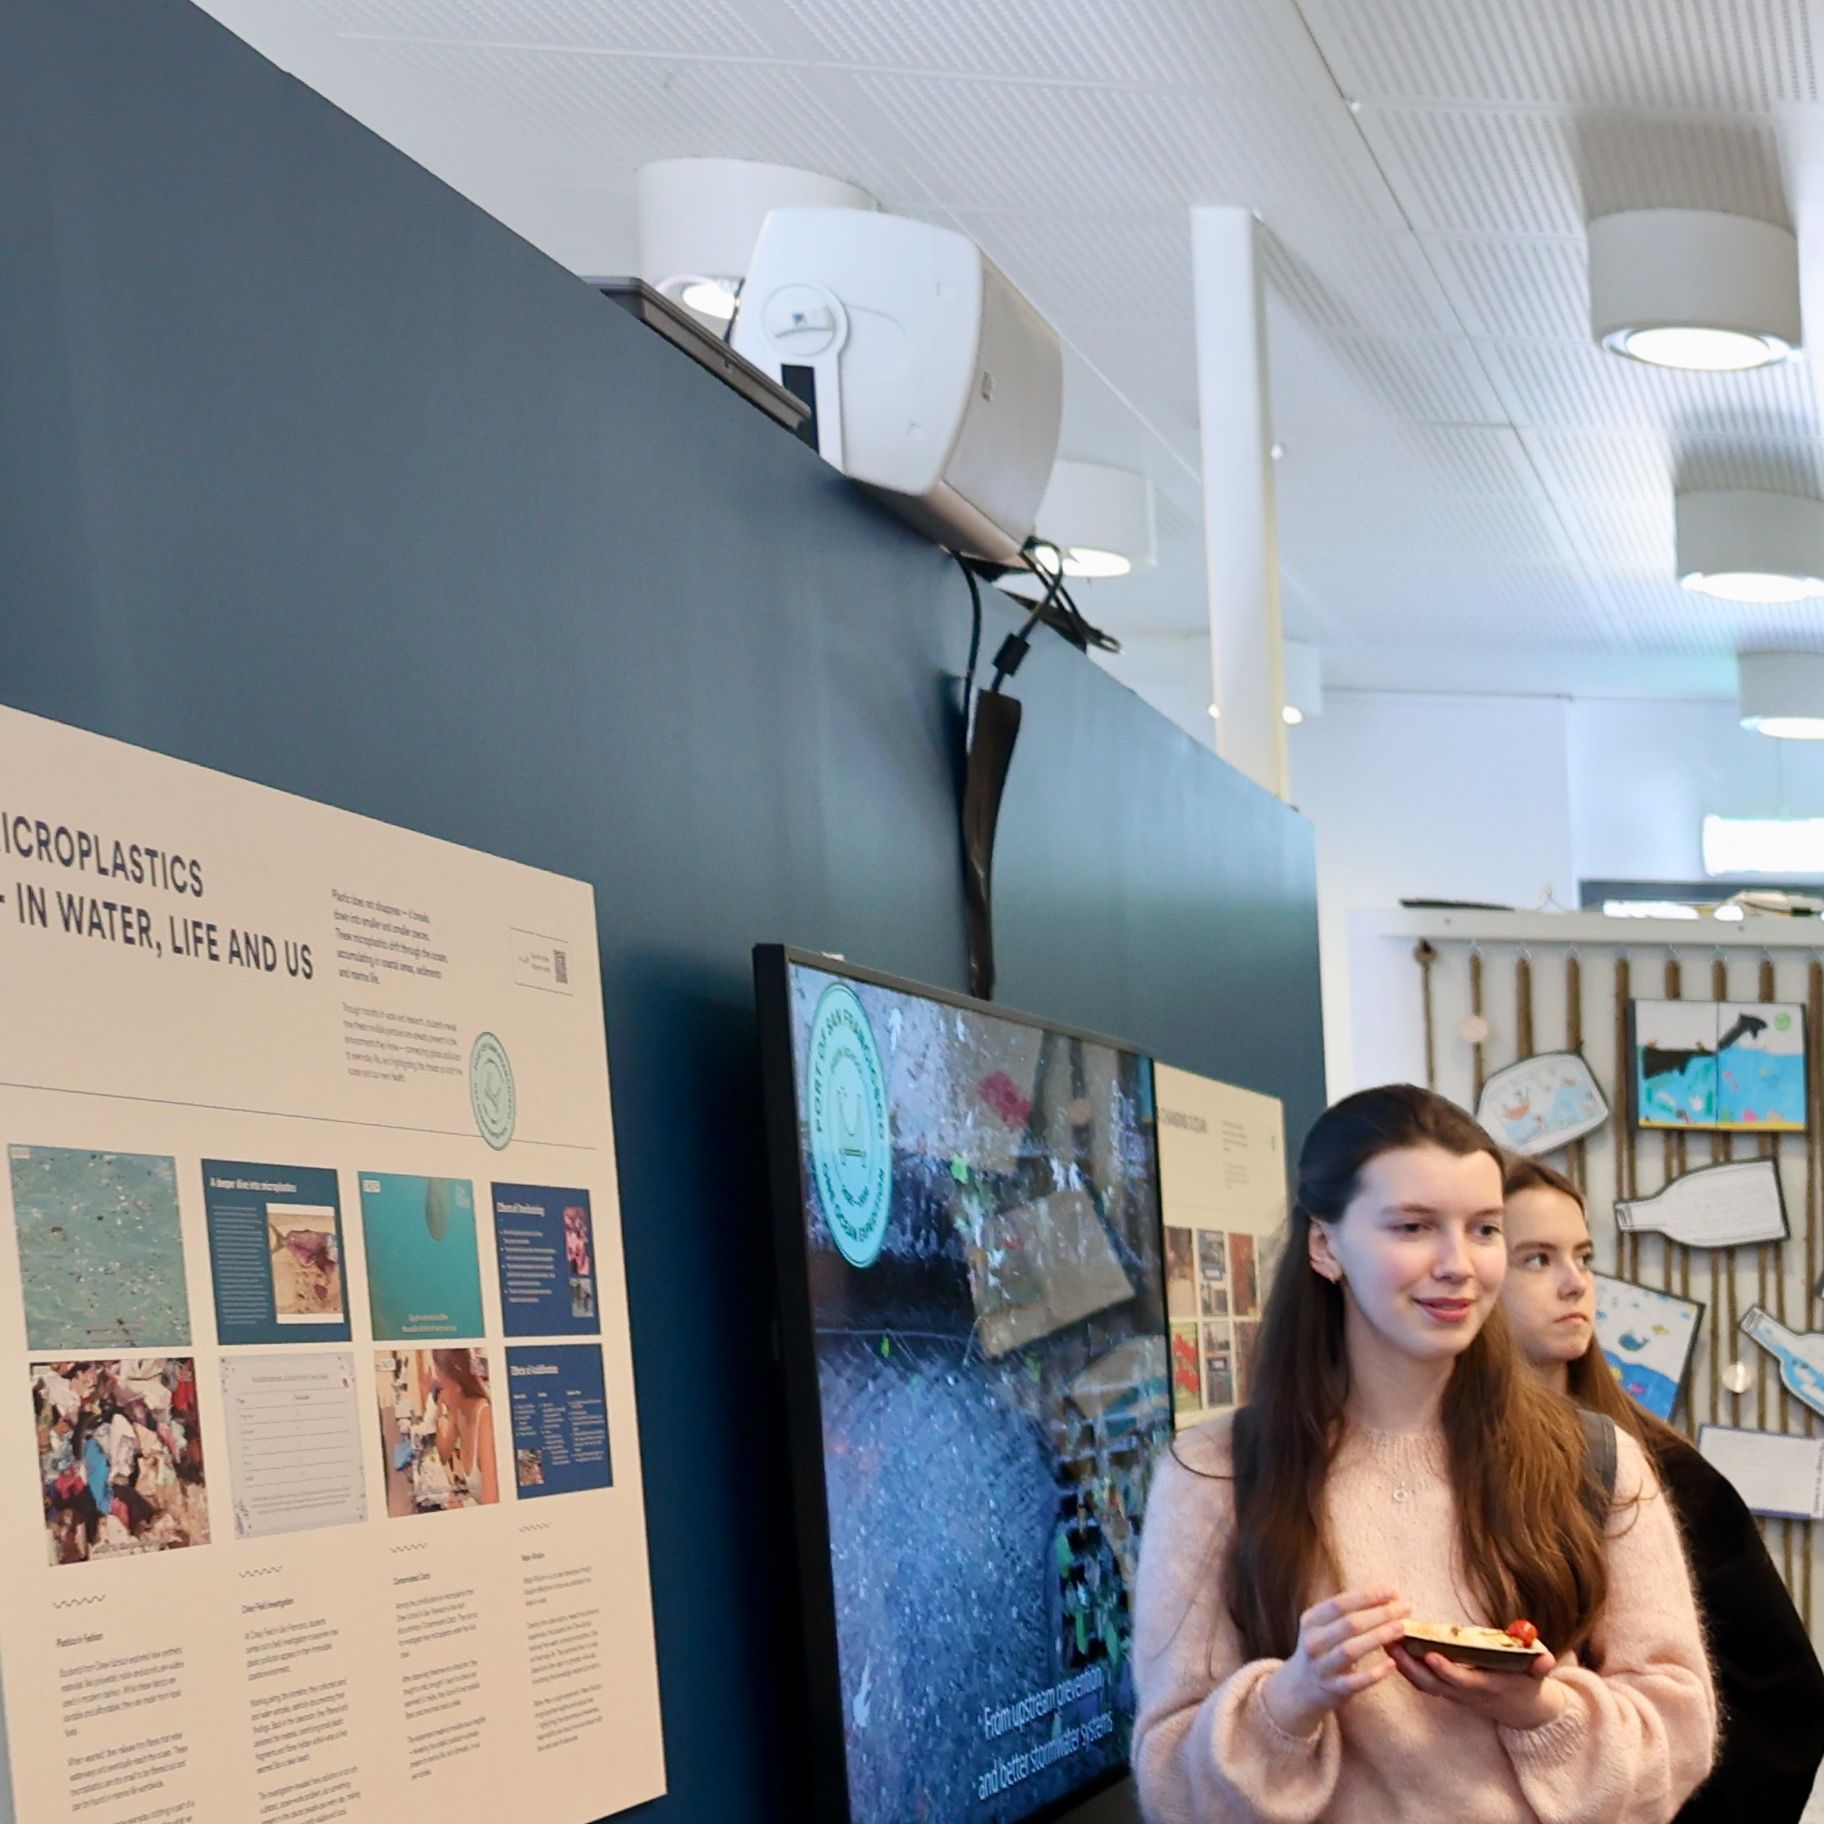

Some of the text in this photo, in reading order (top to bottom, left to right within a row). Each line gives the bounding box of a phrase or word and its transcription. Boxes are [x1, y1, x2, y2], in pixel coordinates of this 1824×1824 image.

[0, 811, 204, 897] ICROPLASTICS
[16, 882, 48, 928] IN
[56, 891, 162, 958] WATER,
[169, 915, 220, 962] LIFE
[228, 929, 278, 972] AND
[283, 940, 313, 980] US
[984, 1704, 1012, 1740] From
[1012, 1687, 1055, 1732] upstream
[978, 1758, 999, 1800] and
[1000, 1753, 1029, 1789] better
[1031, 1730, 1079, 1773] stormwater
